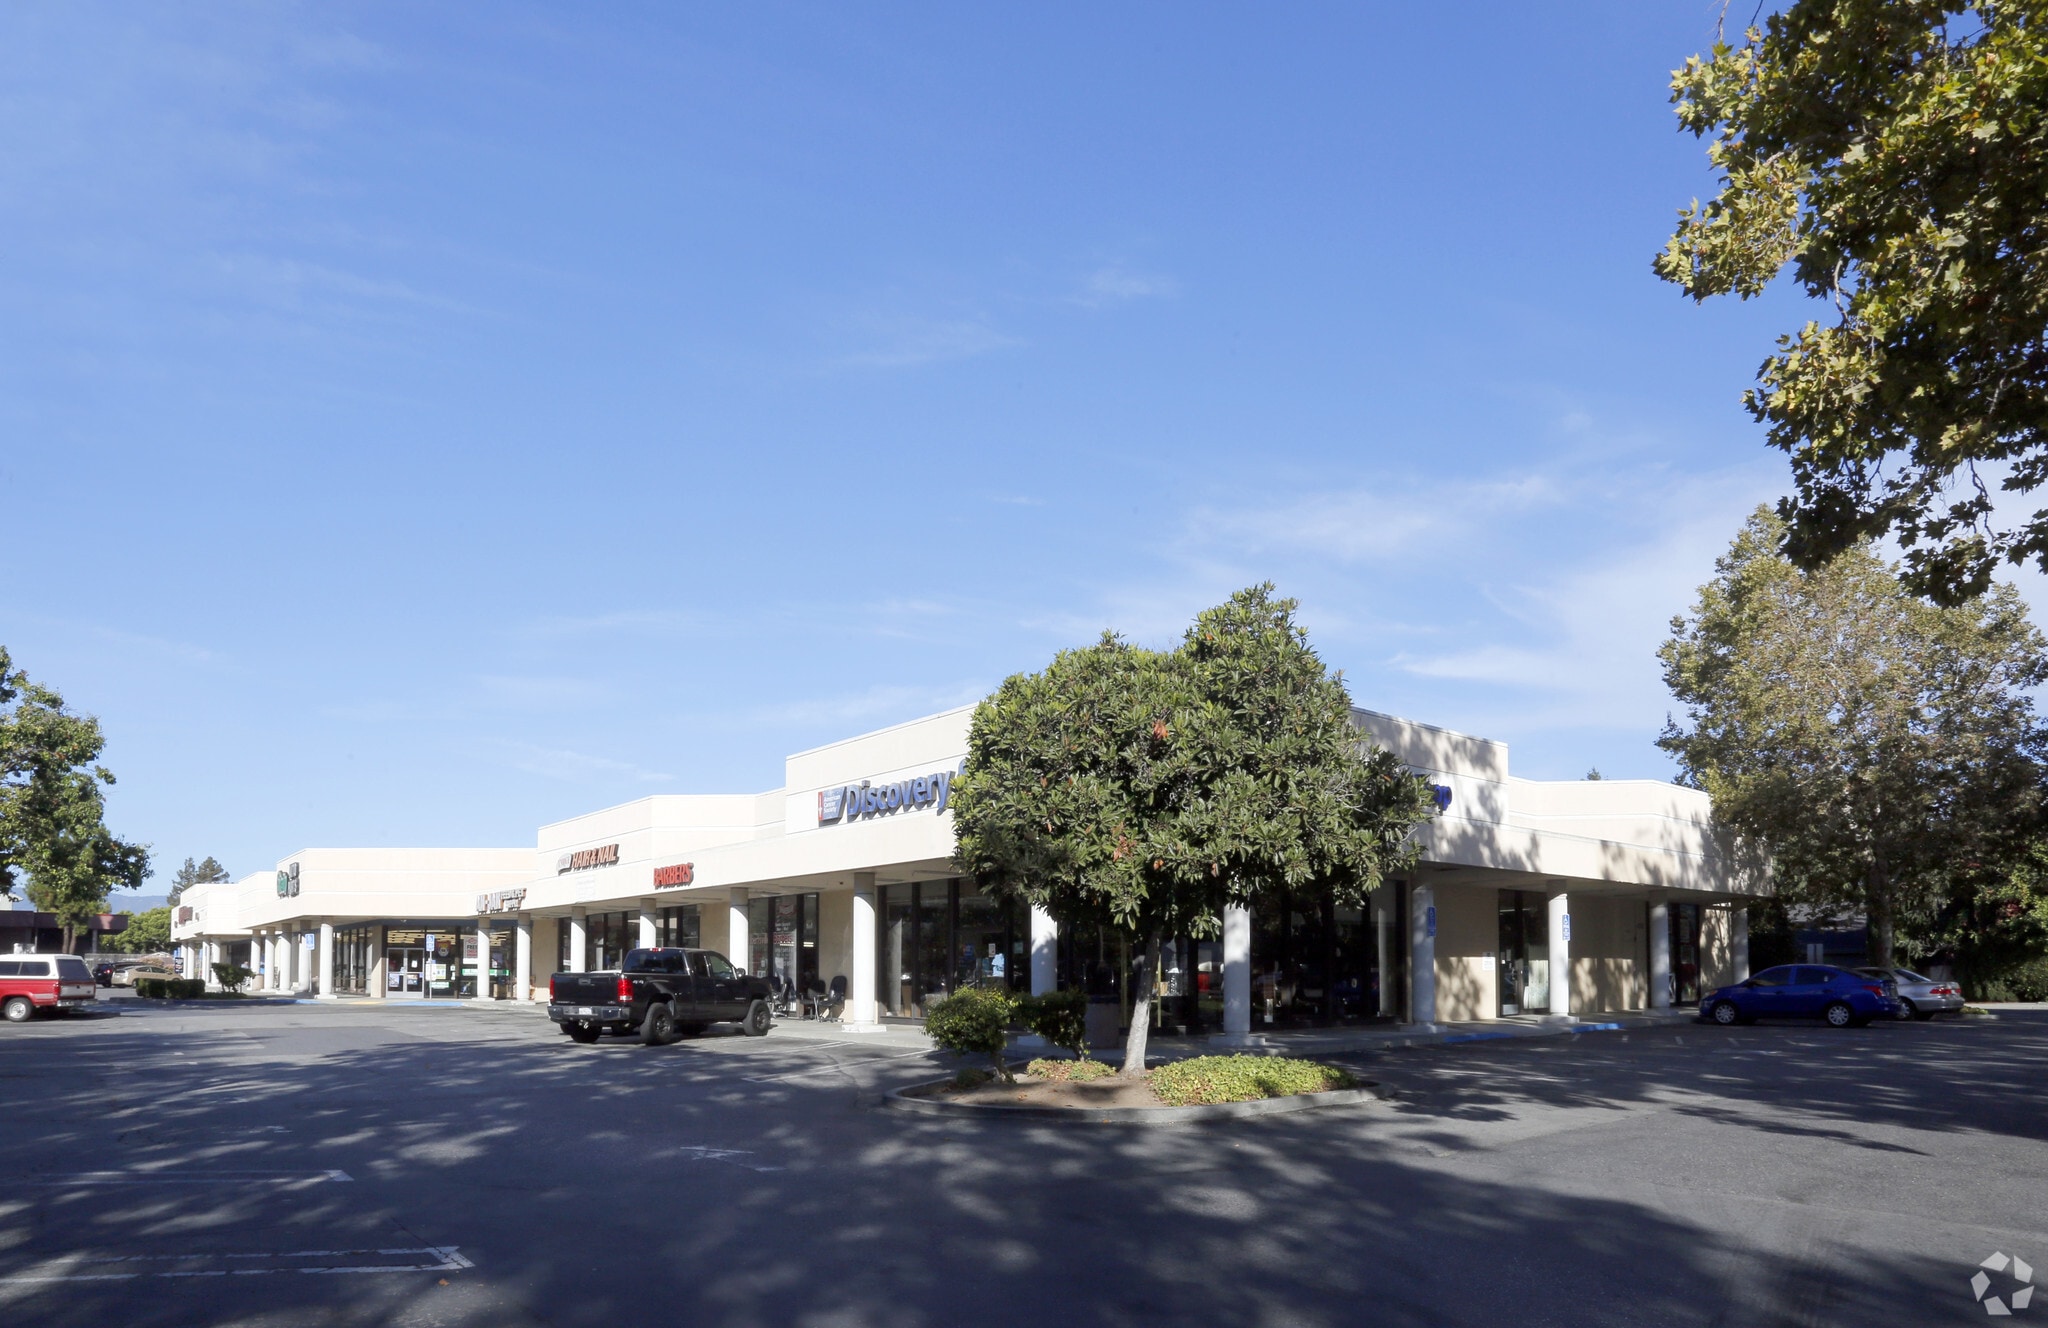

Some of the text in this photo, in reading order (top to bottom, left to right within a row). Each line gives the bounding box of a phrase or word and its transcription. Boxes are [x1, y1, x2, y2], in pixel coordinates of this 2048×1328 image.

[847, 771, 955, 816] Discovery
[572, 849, 592, 868] HAIR
[590, 848, 598, 865] &
[597, 844, 618, 863] NAIL
[654, 864, 694, 886] BARBERS
